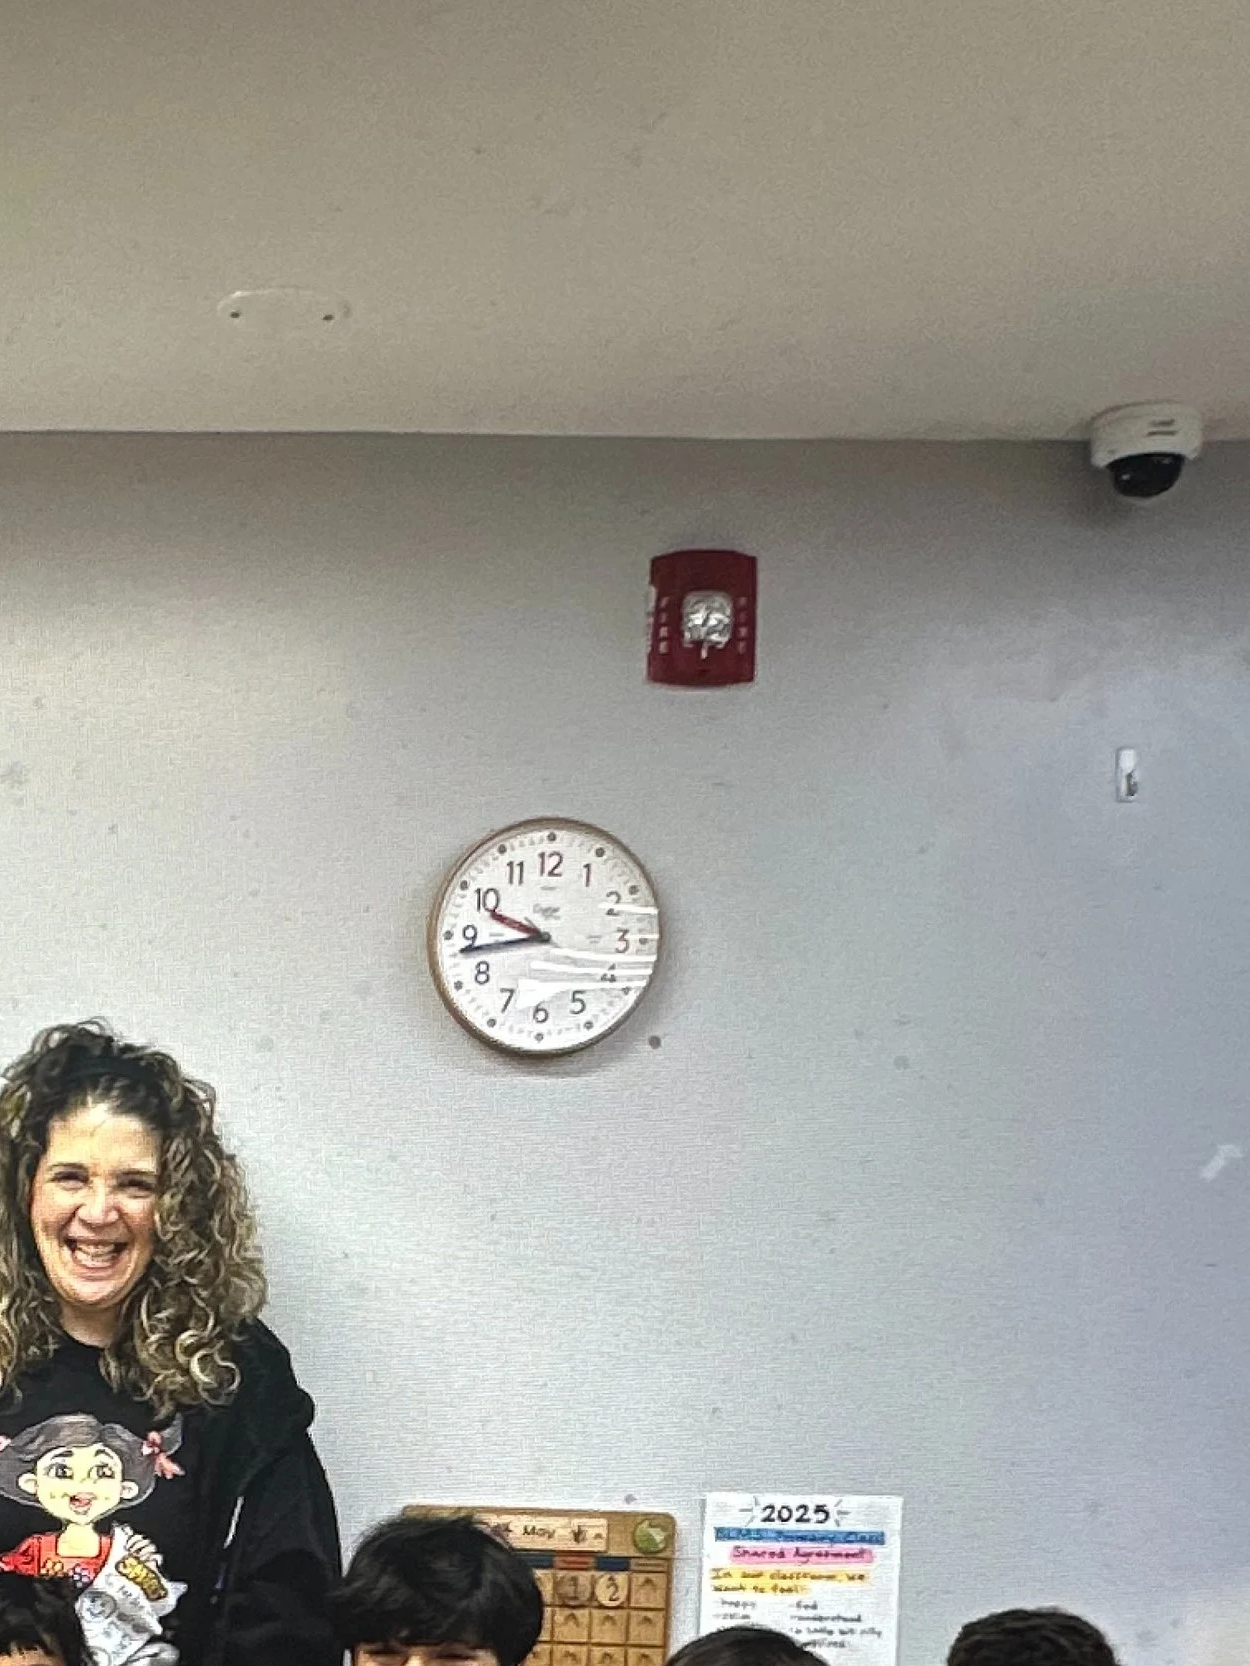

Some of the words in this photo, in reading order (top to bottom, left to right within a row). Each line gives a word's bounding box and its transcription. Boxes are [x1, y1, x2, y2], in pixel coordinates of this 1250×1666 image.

[506, 861, 525, 885] 11
[537, 851, 563, 877] 12
[582, 863, 592, 887] 1
[474, 888, 500, 913] 10
[462, 925, 477, 949] 9
[615, 929, 630, 953] 3
[474, 961, 490, 985] 8
[500, 988, 515, 1013] 7
[533, 1001, 549, 1023] 6
[569, 990, 586, 1014] 5
[760, 1504, 830, 1523] 2025
[607, 1582, 620, 1602] 2
